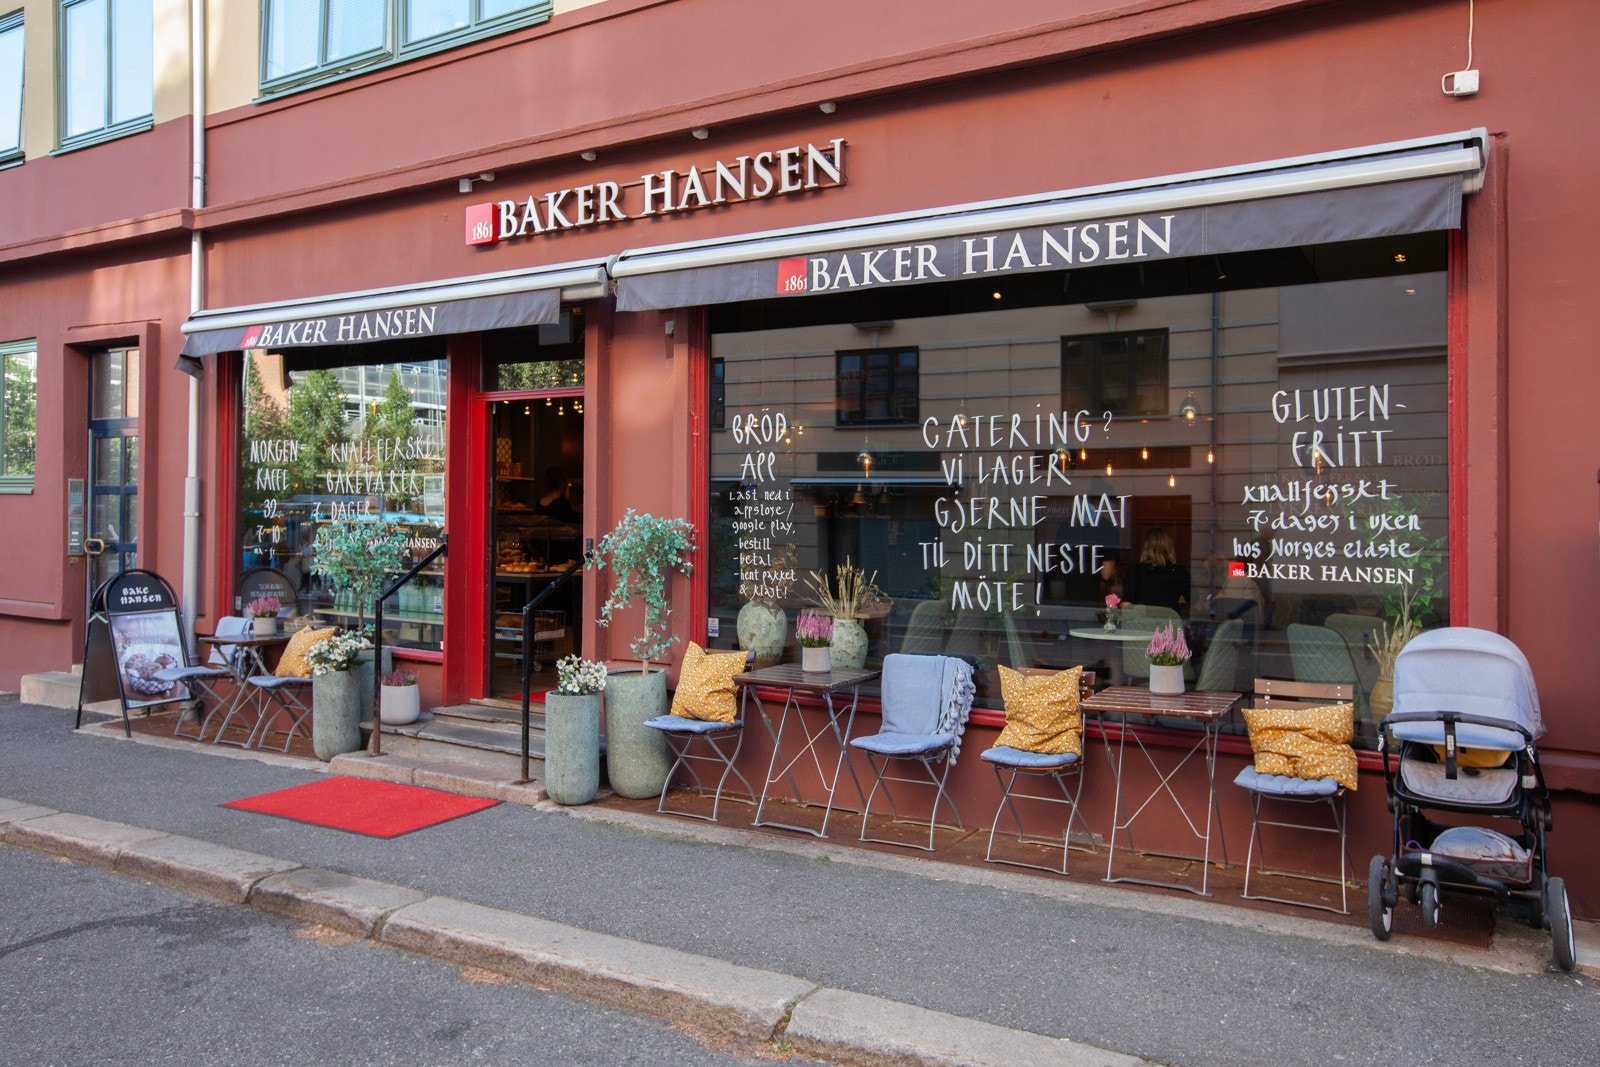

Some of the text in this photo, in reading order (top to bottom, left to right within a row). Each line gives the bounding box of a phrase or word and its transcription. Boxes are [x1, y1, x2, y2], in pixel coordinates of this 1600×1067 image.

[472, 138, 845, 240] 1861 BAKER HANSEN
[785, 215, 1175, 292] 1861 BAKER HANSEN
[257, 319, 328, 347] BAKER
[336, 306, 437, 342] HANSEN
[1272, 383, 1407, 424] GLUTEN-
[732, 408, 787, 445] BRÖD
[1292, 425, 1394, 468] FRITT
[256, 468, 290, 491] KAFFE
[740, 451, 777, 483] APP
[978, 453, 1072, 487] LAGER
[764, 489, 782, 501] ned
[785, 488, 791, 501] i
[934, 490, 1132, 534] GJERNE MAT
[732, 519, 767, 534] google
[1246, 510, 1269, 533] 7
[1349, 511, 1357, 531] i
[918, 536, 1105, 575] TIL DITT NESTE
[1233, 537, 1424, 562] hos Norges eldste
[1247, 563, 1314, 581] BAKER
[1321, 565, 1415, 585] HANSEN
